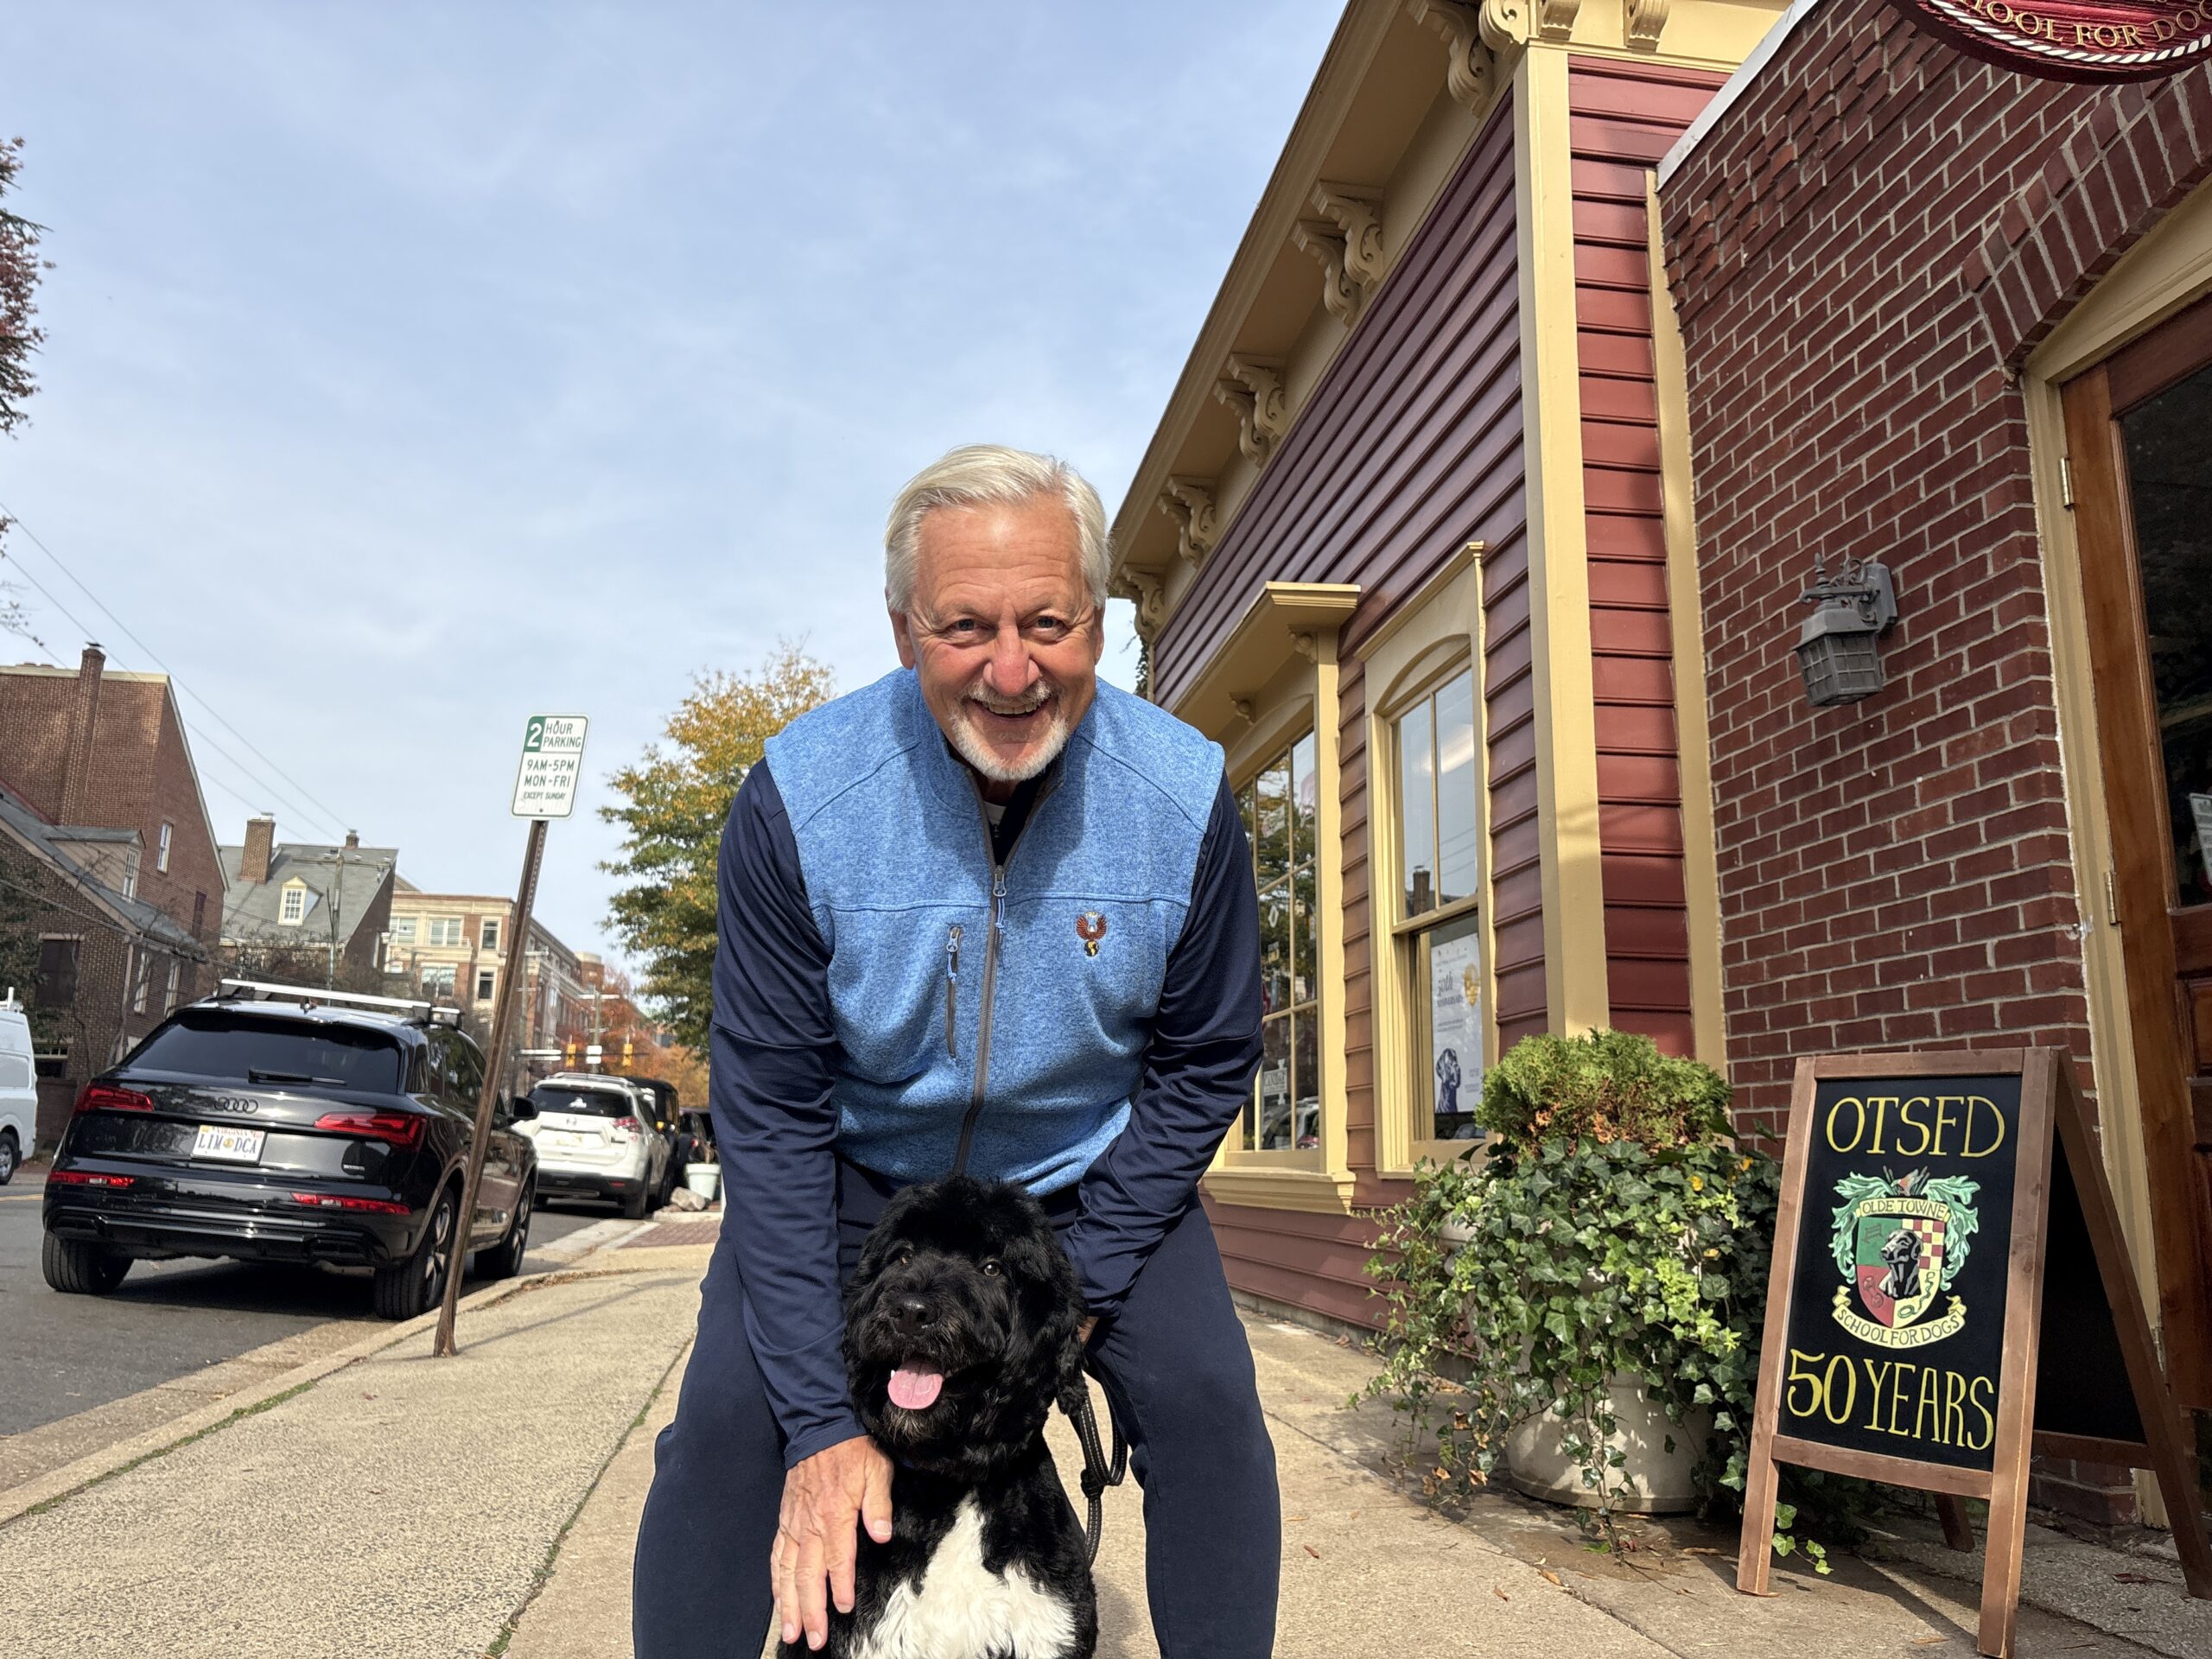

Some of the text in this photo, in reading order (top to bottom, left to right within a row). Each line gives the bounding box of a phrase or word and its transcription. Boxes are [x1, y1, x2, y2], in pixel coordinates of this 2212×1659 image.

[2073, 23, 2146, 48] FOR
[527, 722, 574, 747] 2 HOUR
[543, 736, 582, 748] PARKING
[523, 791, 566, 800] EXCEPT SUNDAY
[1826, 1095, 2005, 1158] OTSFD
[233, 1136, 257, 1154] DCA
[1862, 1199, 1947, 1219] OLDE TOWNE
[1837, 1308, 1961, 1346] SCHOOL FOR DOGS
[1787, 1348, 1994, 1450] 50 YEARS
